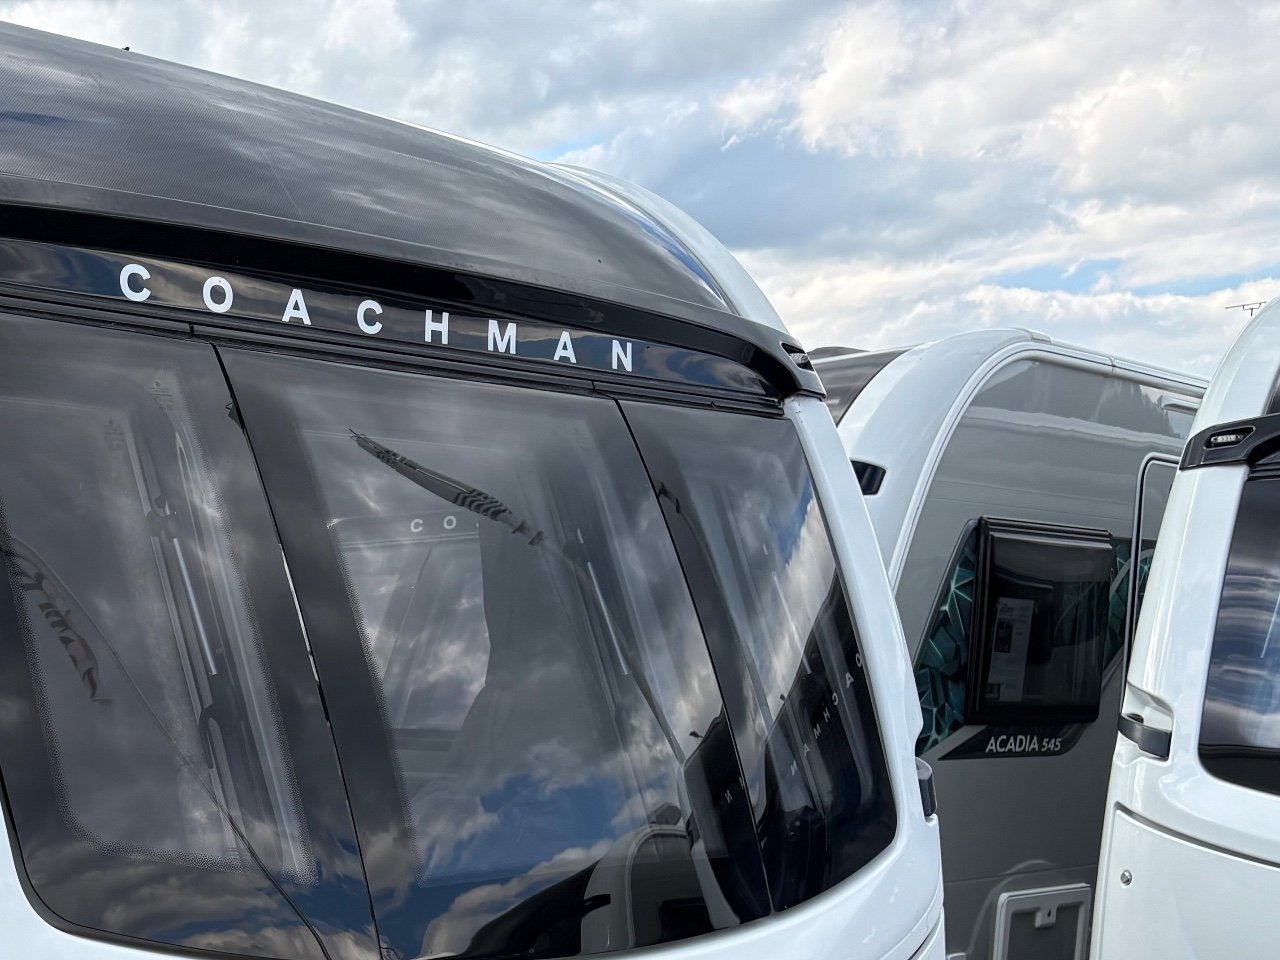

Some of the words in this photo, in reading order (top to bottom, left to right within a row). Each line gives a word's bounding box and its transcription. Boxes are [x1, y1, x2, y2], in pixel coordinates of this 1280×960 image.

[119, 263, 633, 372] COACHMAN
[986, 735, 1039, 752] ACADIA
[1041, 737, 1062, 751] 545
